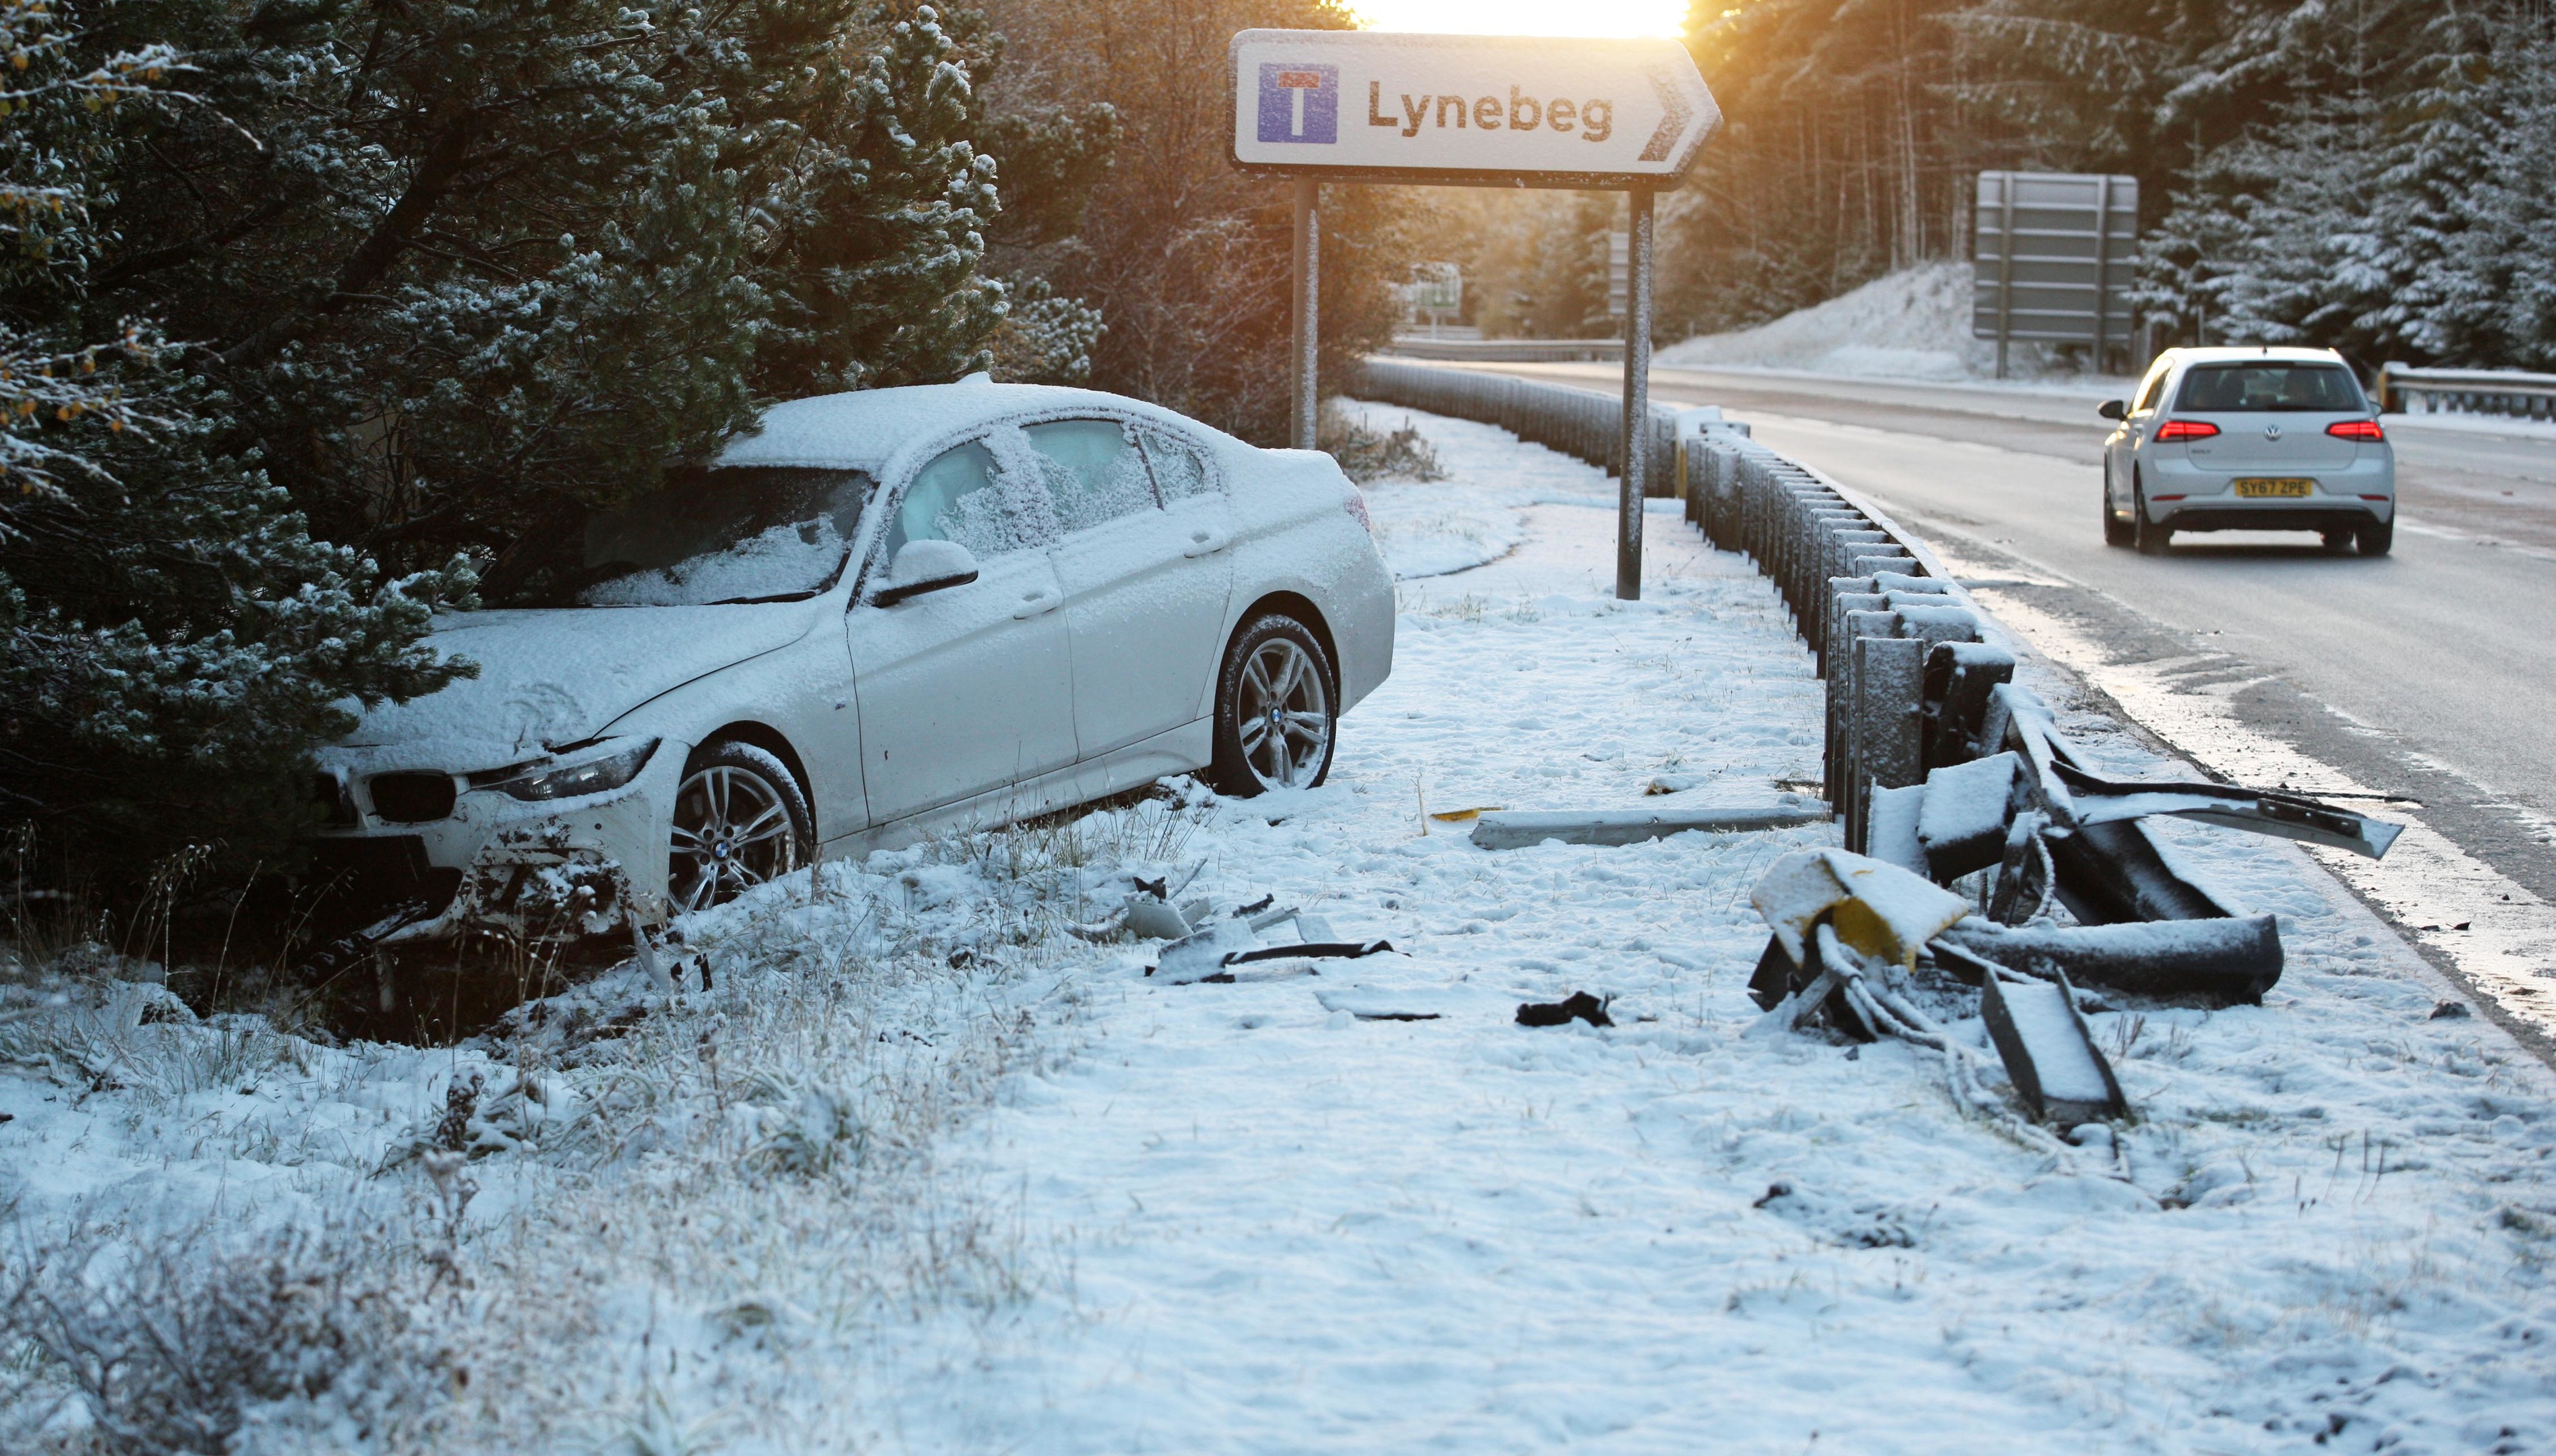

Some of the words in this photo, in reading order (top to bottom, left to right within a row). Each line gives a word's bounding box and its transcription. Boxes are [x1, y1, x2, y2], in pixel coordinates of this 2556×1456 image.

[1369, 81, 1613, 142] Lynebeg
[2240, 481, 2276, 494] SY67
[2280, 481, 2307, 494] ZPE
